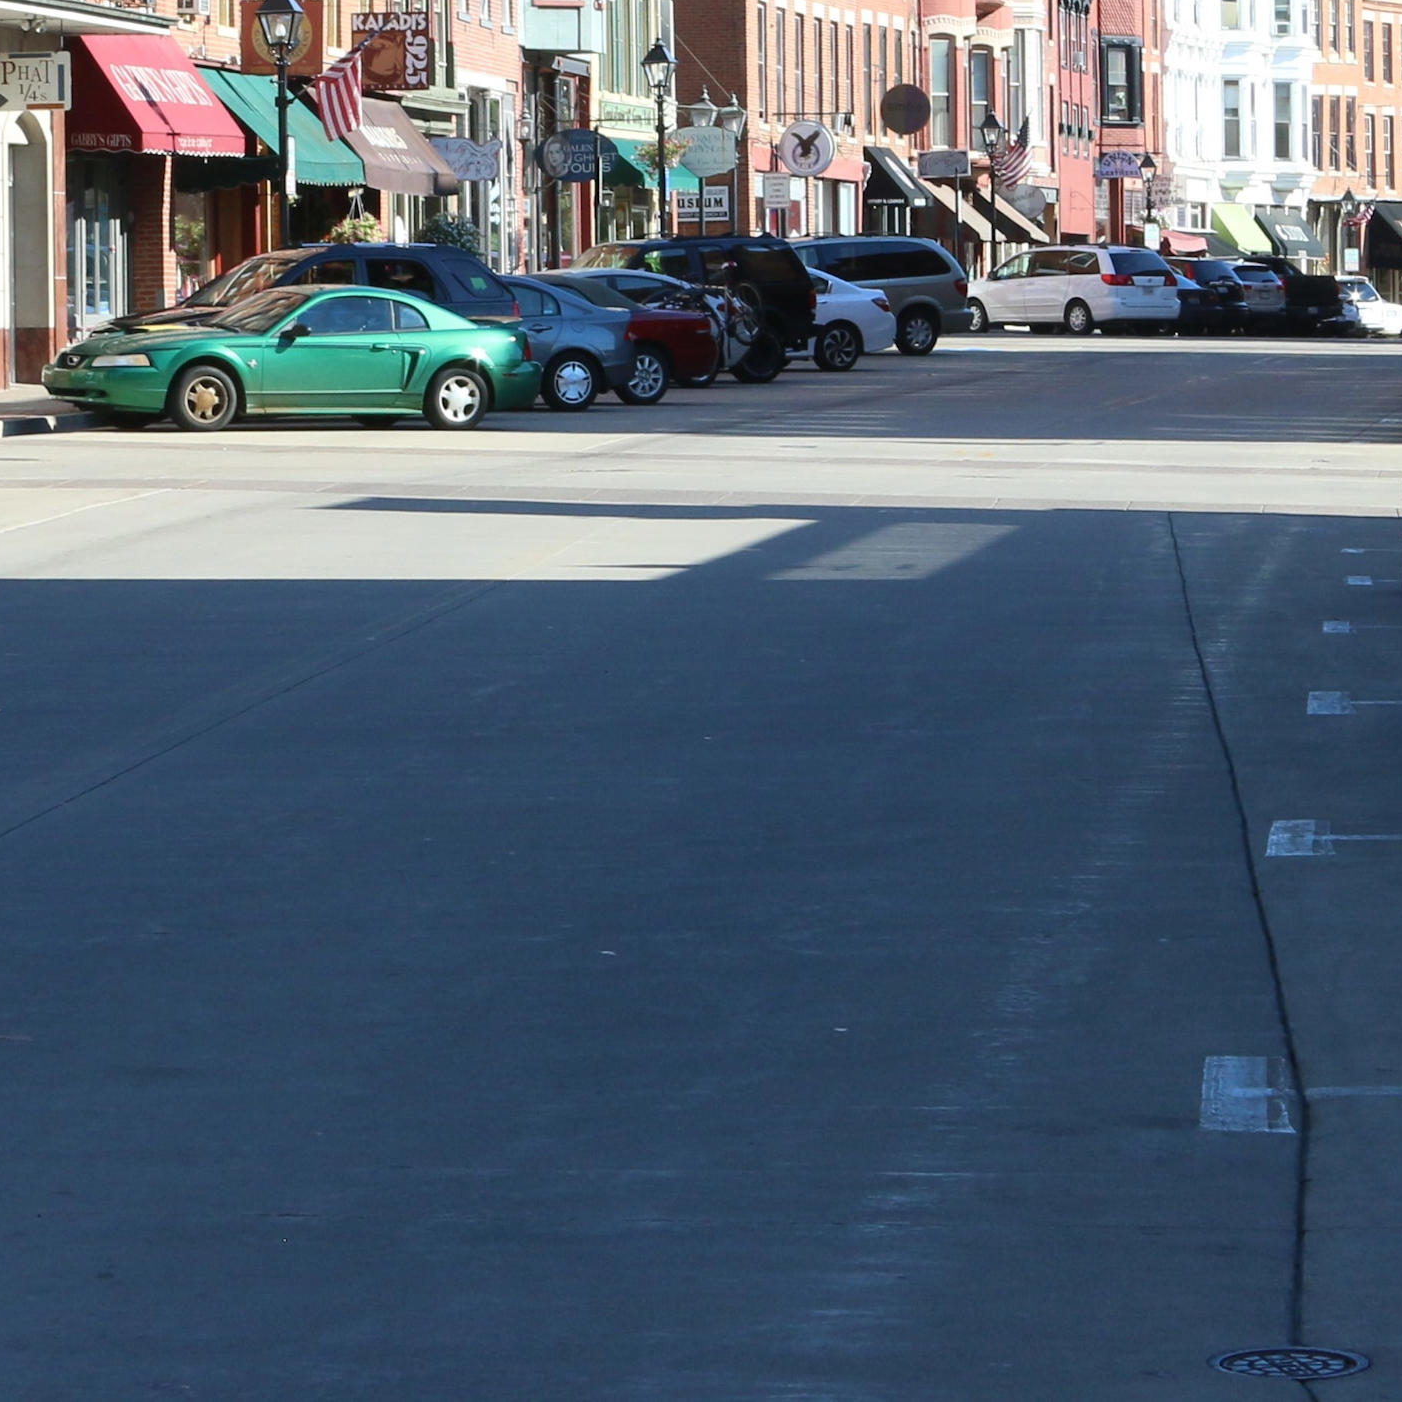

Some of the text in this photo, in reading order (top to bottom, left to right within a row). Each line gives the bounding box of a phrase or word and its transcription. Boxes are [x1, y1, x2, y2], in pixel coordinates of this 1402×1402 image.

[405, 30, 428, 87] 925
[71, 133, 132, 147] GABBY'S GIFTS
[574, 152, 617, 162] GHST
[1103, 151, 1135, 167] UNION
